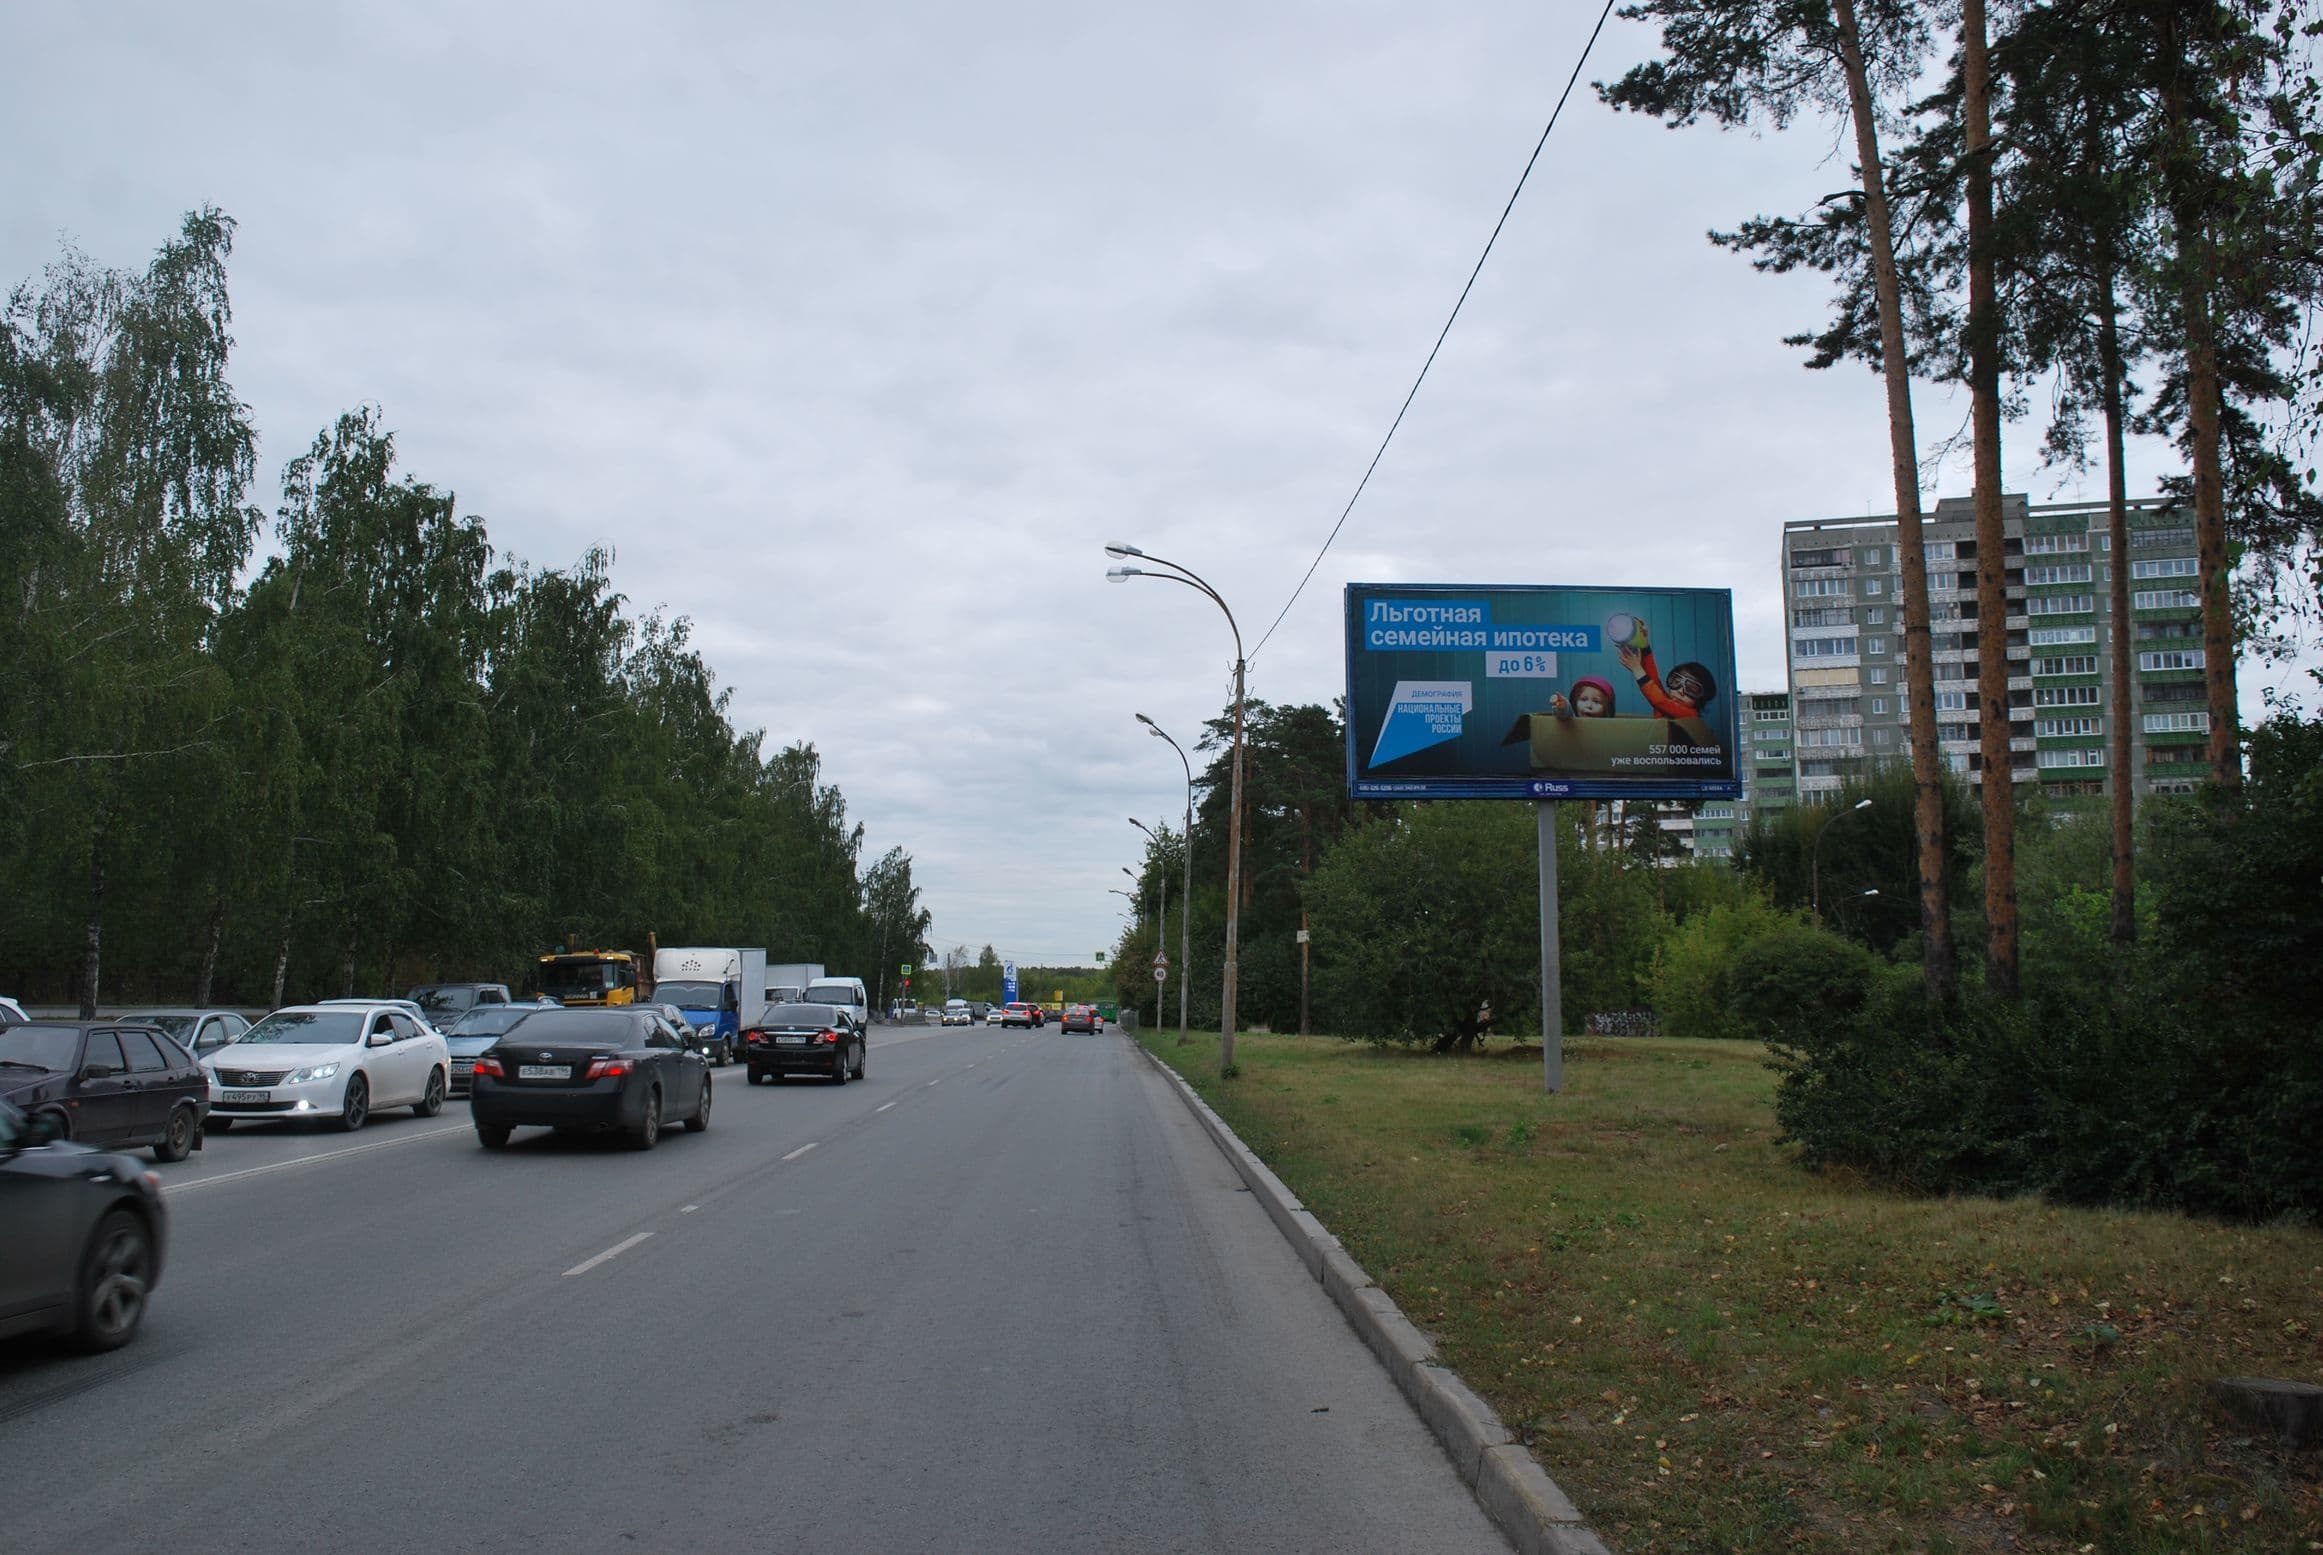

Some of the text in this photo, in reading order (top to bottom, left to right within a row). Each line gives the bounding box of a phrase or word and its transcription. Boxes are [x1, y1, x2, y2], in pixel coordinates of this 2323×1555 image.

[1370, 602, 1481, 623] Льготная
[1370, 626, 1588, 647] семейная ипотека
[1499, 659, 1520, 674] до
[1397, 703, 1461, 714] НАЦИОНАЛЬНЫЕ
[1425, 714, 1461, 724] ПРОЕКТЫ
[1431, 724, 1462, 734] РОССИИ
[1649, 745, 1721, 754] 557 000 семей
[1611, 757, 1722, 767] уже воспользовались
[1544, 782, 1569, 792] Russ
